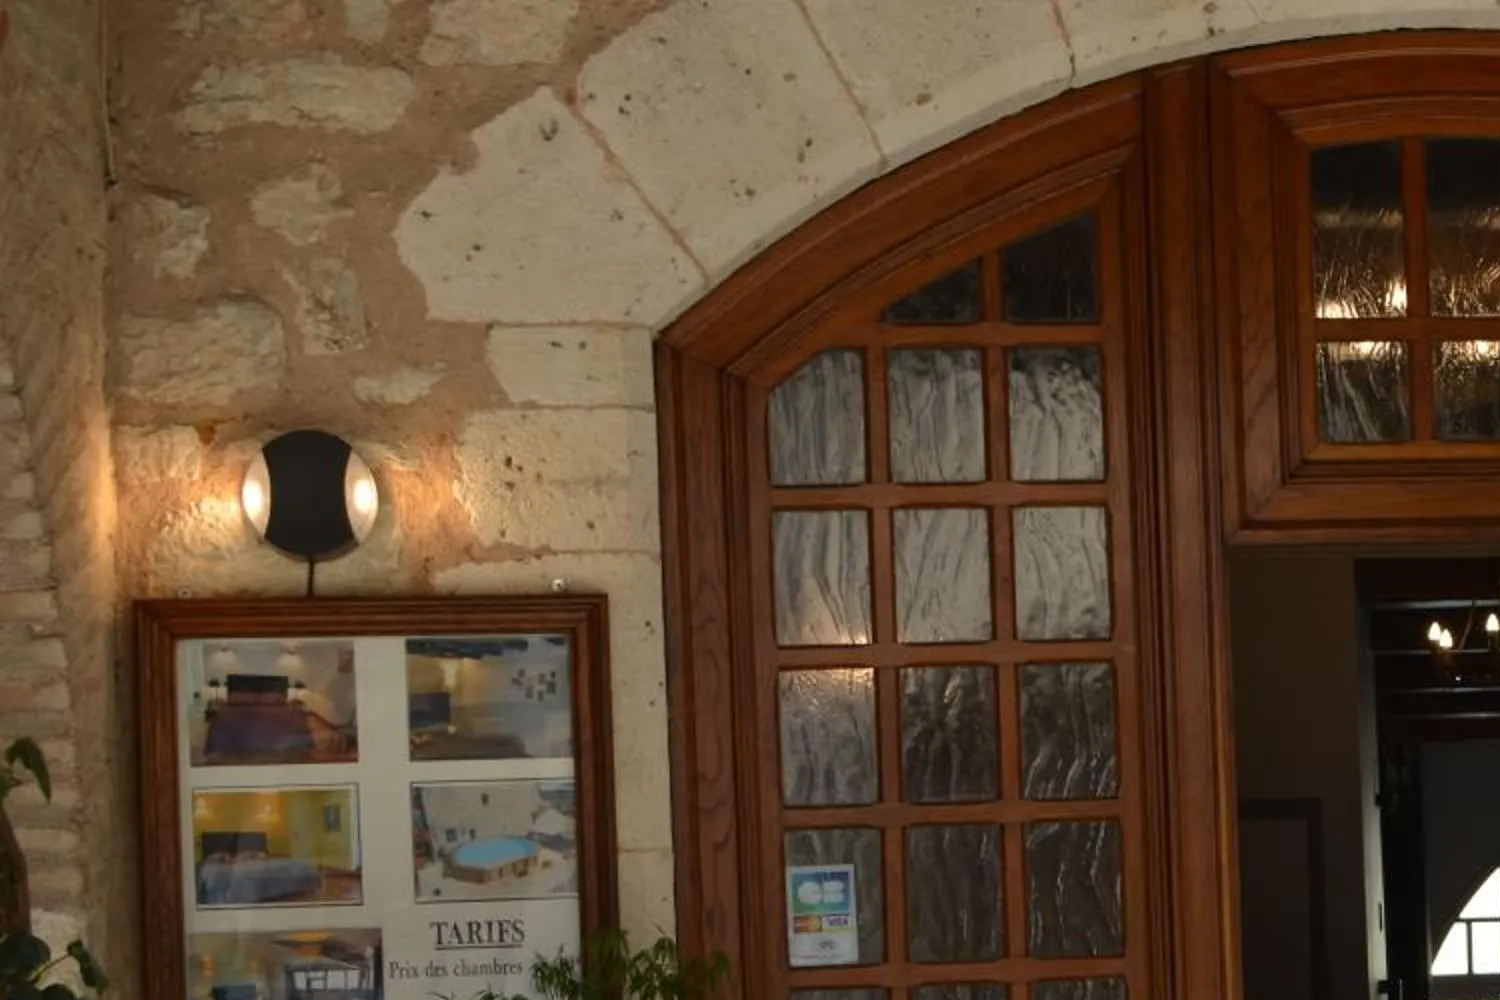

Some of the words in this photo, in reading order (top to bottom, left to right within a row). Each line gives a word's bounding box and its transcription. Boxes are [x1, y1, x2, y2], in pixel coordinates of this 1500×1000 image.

[429, 919, 525, 946] TARIFS
[389, 960, 420, 980] Prix
[426, 959, 448, 977] des
[453, 957, 523, 977] chambres
